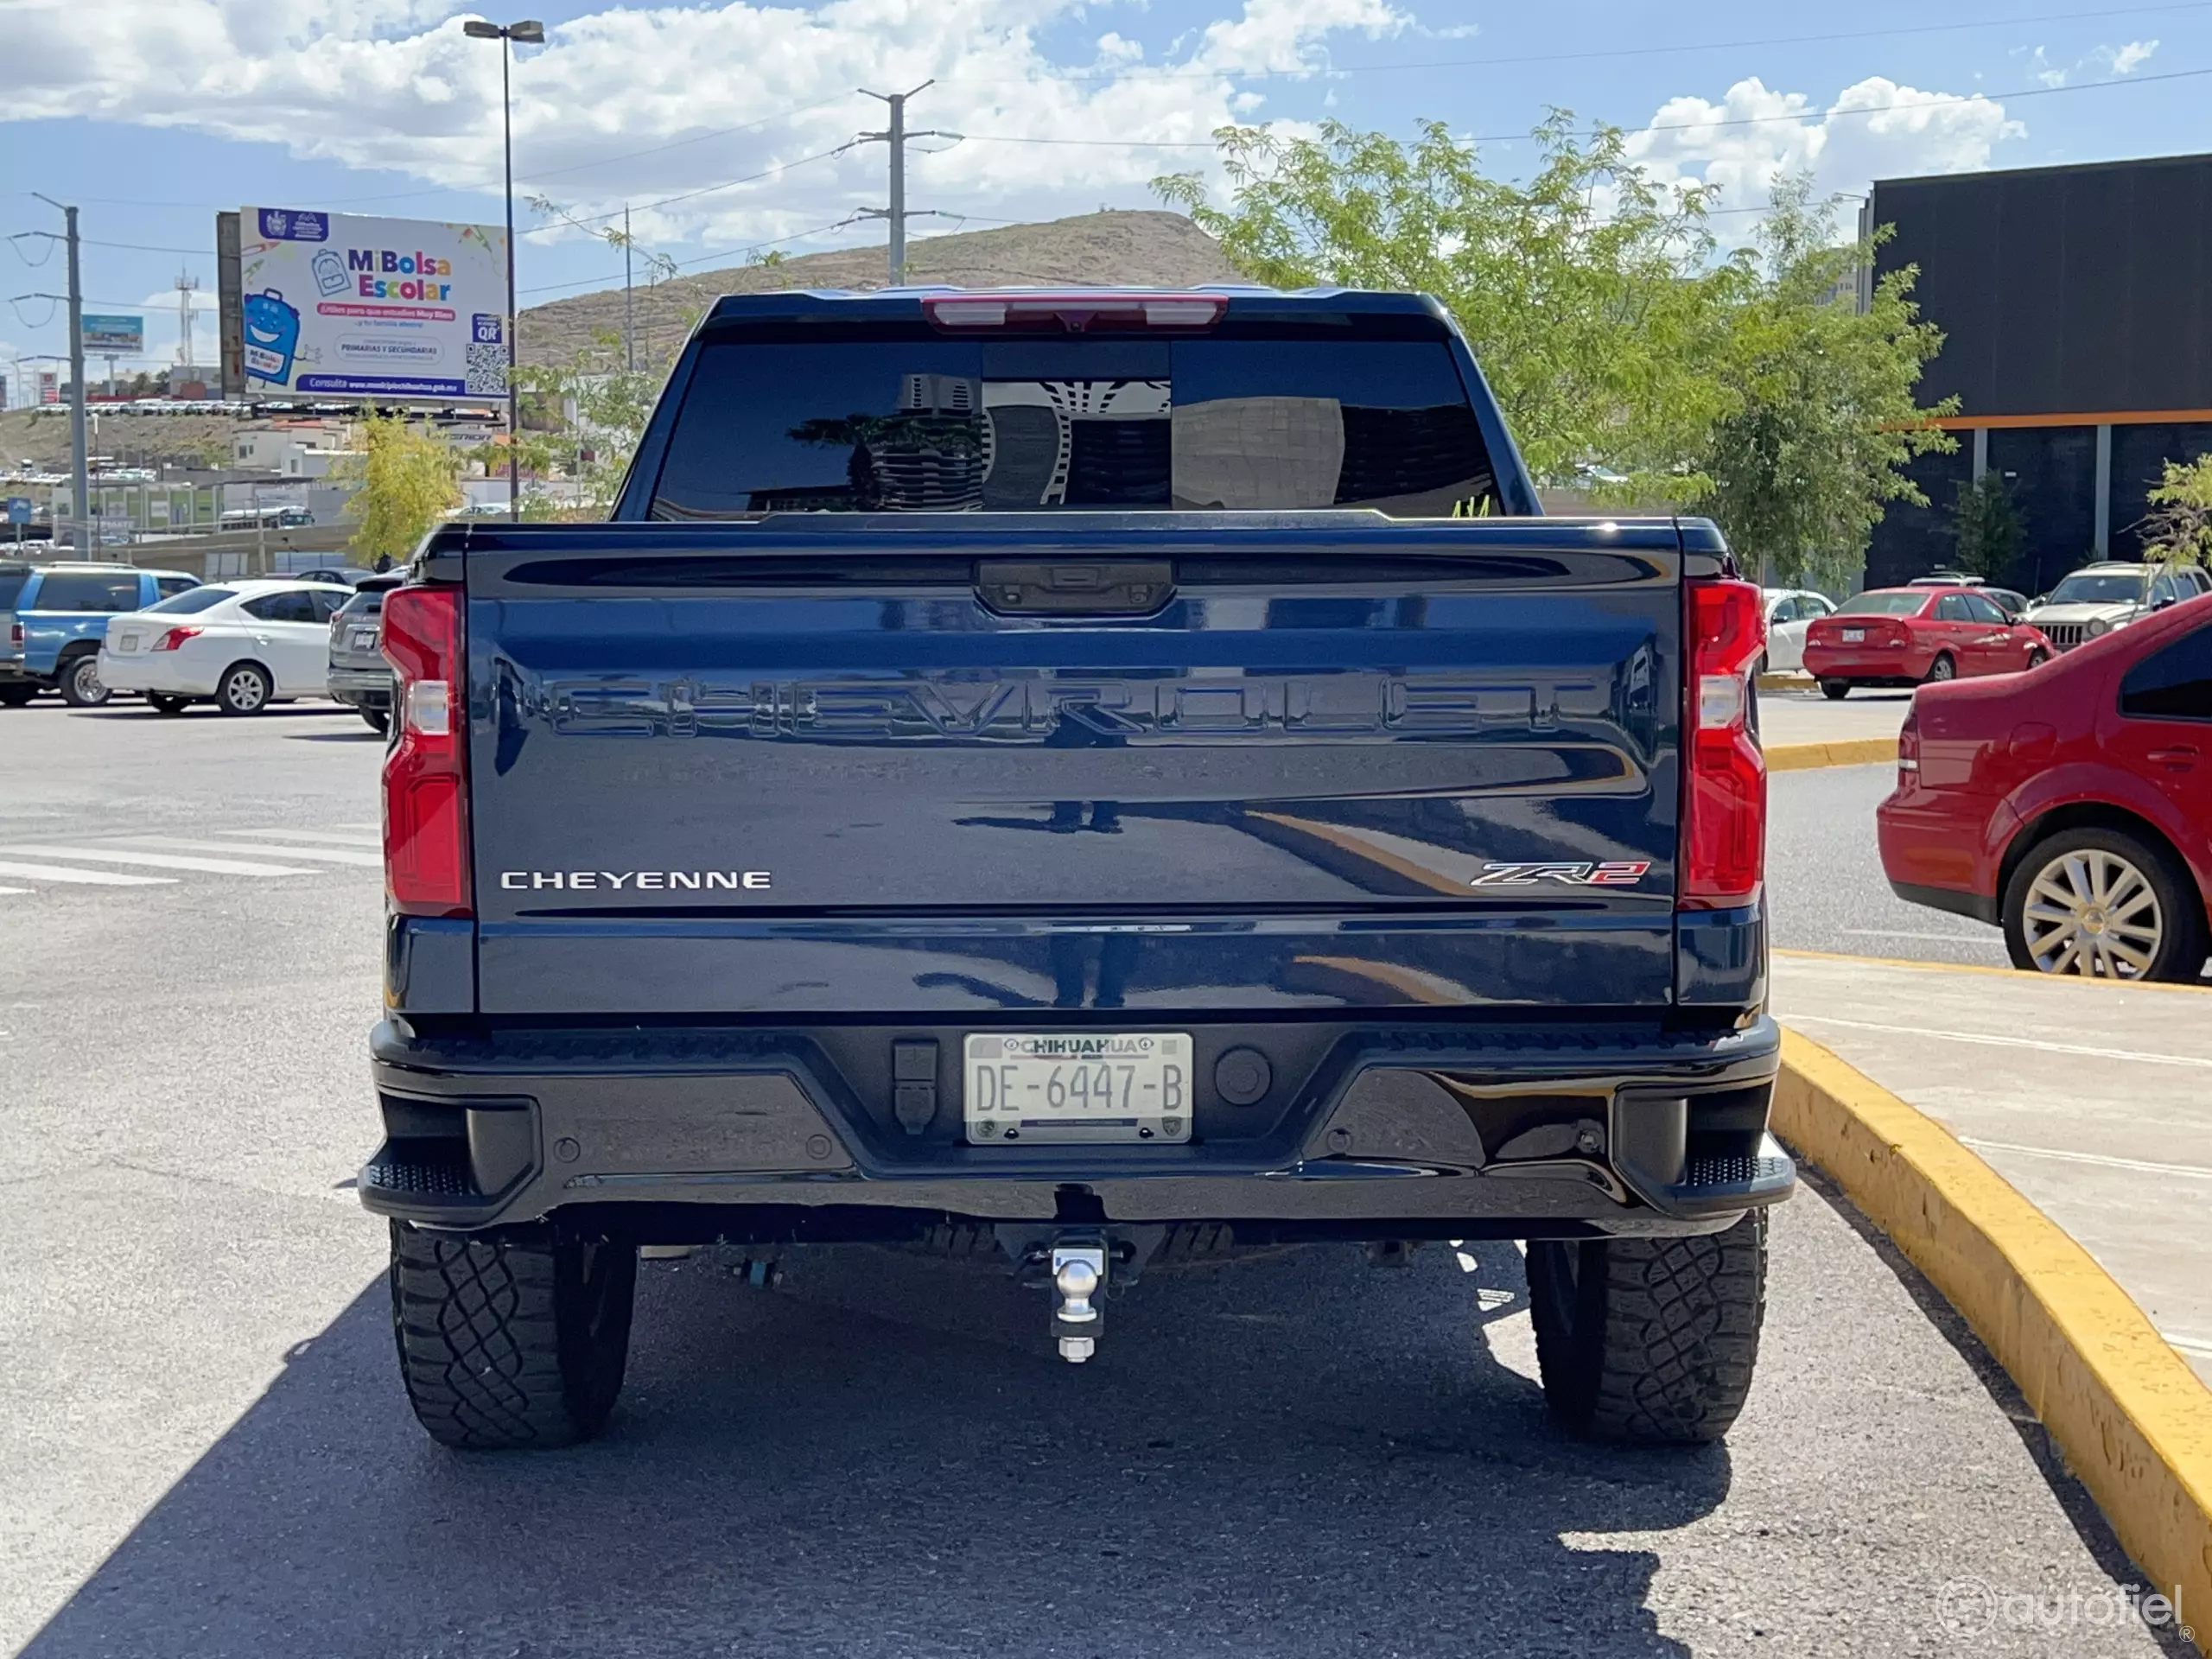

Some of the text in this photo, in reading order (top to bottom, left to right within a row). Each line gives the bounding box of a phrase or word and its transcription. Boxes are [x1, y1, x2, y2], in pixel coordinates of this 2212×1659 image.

[359, 274, 451, 301] Escolar
[416, 310, 434, 320] Muy
[478, 326, 498, 341] QR
[341, 344, 380, 353] PRIMARIAS
[388, 346, 437, 355] SECUNDARIAS
[309, 378, 347, 389] Consulta
[501, 871, 772, 889] CHEYENNE
[1471, 861, 1651, 886] ZR2
[1020, 1039, 1138, 1053] CHIHUAHUA
[976, 1065, 1182, 1111] DE-6447-B
